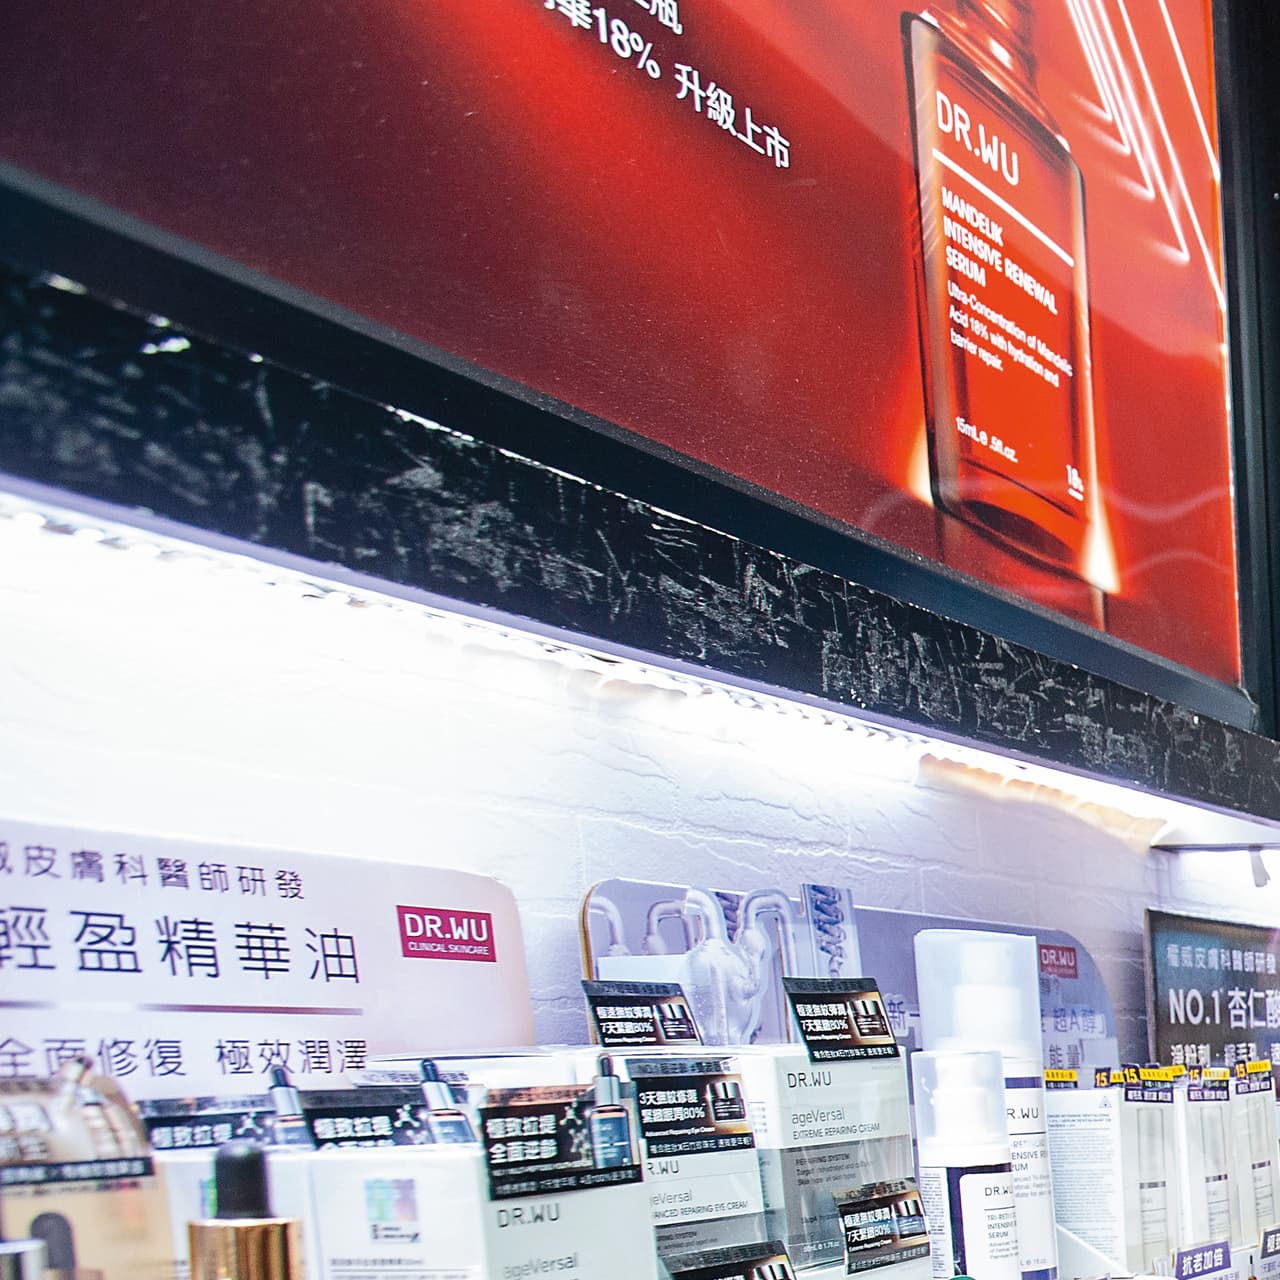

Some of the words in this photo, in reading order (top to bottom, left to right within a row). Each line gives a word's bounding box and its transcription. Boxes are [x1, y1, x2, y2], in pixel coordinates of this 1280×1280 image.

[634, 0, 683, 35] 瓶
[544, 0, 661, 79] 華18%
[674, 62, 790, 168] 升級上市
[936, 90, 1019, 186] DR.WU
[941, 186, 1004, 247] MANDELIK
[943, 215, 1002, 272] INTENSIVE
[1004, 257, 1058, 315] RENEWAL
[945, 245, 986, 288] SERUM
[949, 304, 969, 329] Acid
[969, 317, 989, 340] 18%
[989, 331, 1007, 352] with
[1043, 367, 1060, 388] and
[950, 328, 977, 356] barrier
[0, 841, 305, 900] 皮膚科醫師研發
[403, 912, 489, 943] DR.WU
[0, 905, 361, 984] 輕盈精華油
[407, 941, 446, 954] CLINICAL
[448, 943, 489, 956] SKINCARE
[1040, 949, 1076, 966] DR.WU
[215, 1038, 368, 1077] 極效潤澤
[786, 1071, 832, 1089] DR.WU
[791, 1106, 845, 1127] ageVersal
[1006, 1108, 1039, 1120] R.WU
[793, 1128, 823, 1140] EXTREME
[824, 1124, 858, 1137] REPAIRING
[859, 1121, 881, 1134] CREAM
[647, 1159, 680, 1175] R.WU
[1011, 1151, 1038, 1161] ENSIVE
[649, 1189, 693, 1206] eVersal
[496, 1202, 561, 1229] DR.WU
[654, 1207, 679, 1219] ANCED
[680, 1205, 713, 1216] REPAIRING
[988, 1231, 1009, 1240] SERUM
[503, 1252, 579, 1280] ageVersal
[1181, 1247, 1224, 1276] 抗老加倍
